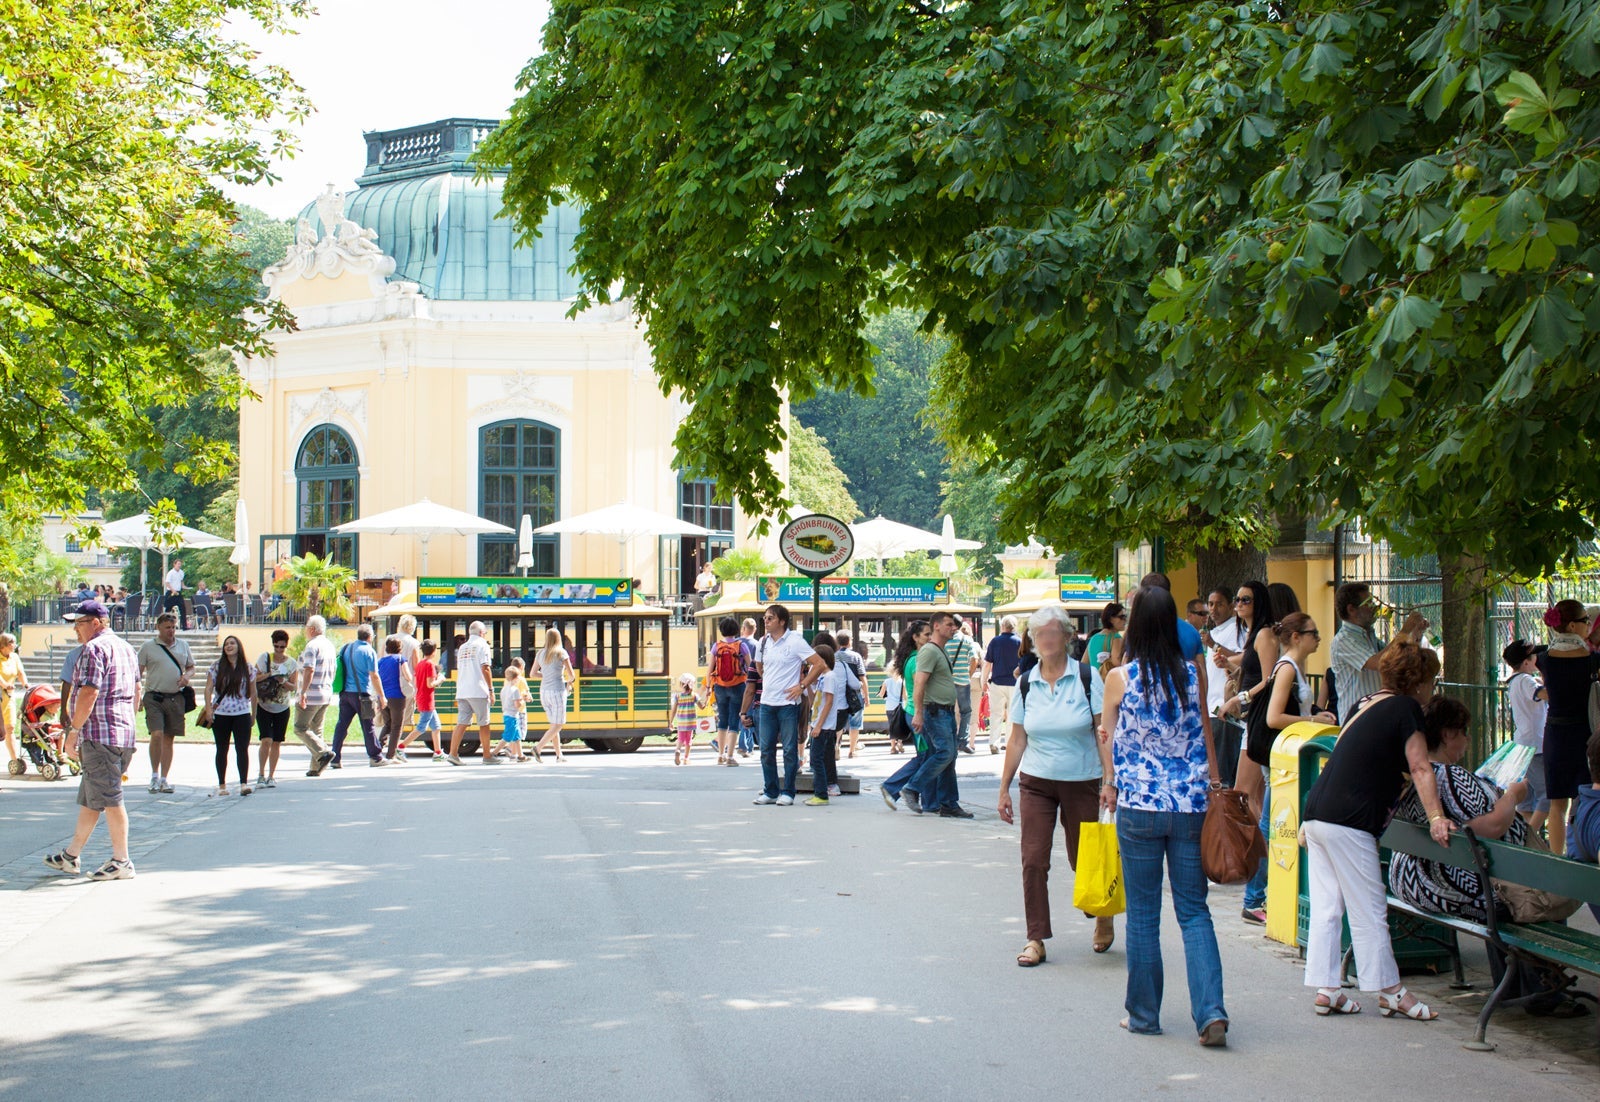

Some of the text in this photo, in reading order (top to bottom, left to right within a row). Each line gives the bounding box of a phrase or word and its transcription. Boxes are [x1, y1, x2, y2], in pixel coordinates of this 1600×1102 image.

[786, 519, 847, 541] SCHÖNBRUNNER
[786, 545, 848, 569] TIERGARTEN BAHN
[785, 582, 922, 599] Tiergarten Schönbrunn
